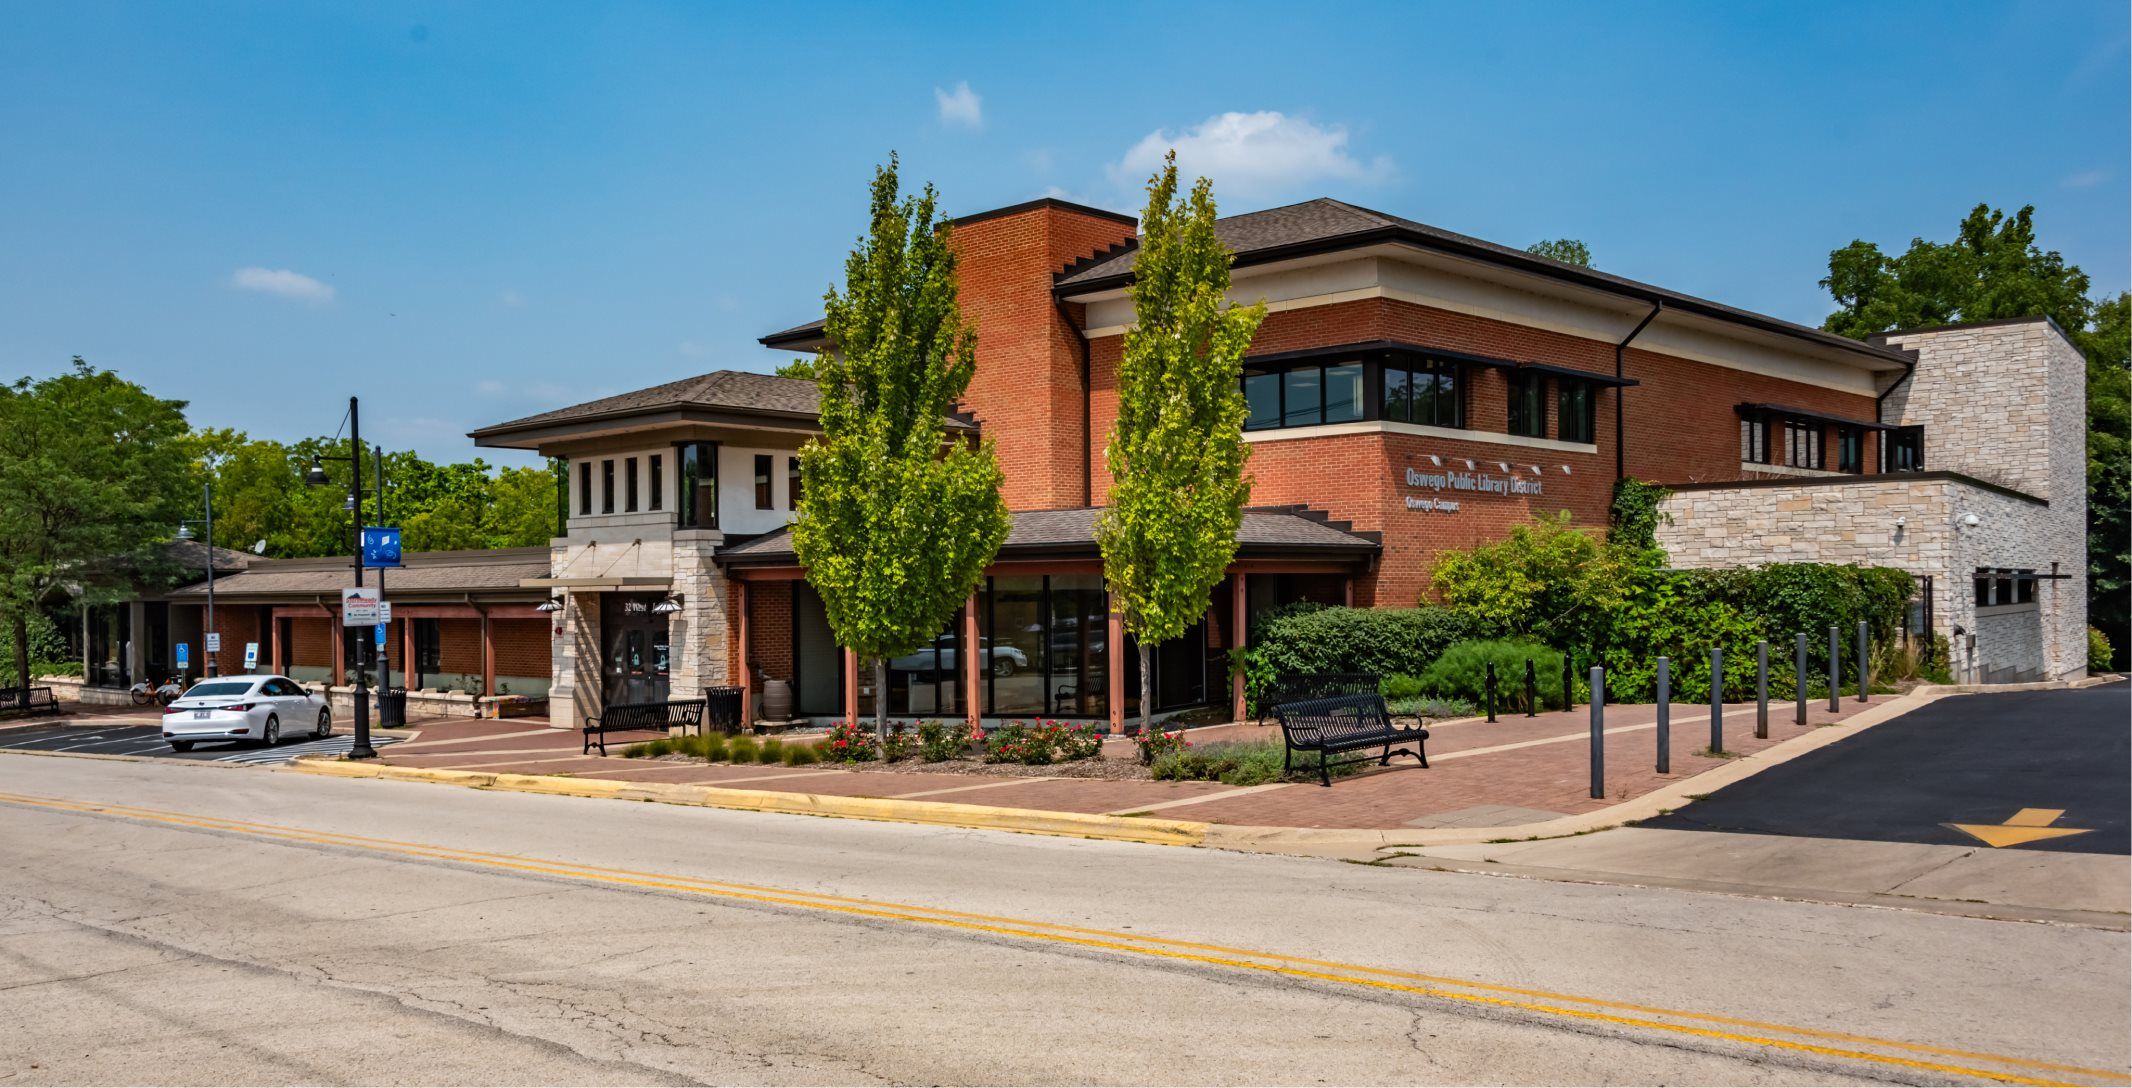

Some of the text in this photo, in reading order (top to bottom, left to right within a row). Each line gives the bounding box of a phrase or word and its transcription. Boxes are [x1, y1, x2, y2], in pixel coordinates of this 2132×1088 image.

[1407, 468, 1542, 496] Oswego Public Library District
[1406, 497, 1459, 512] Oswego Campus
[625, 603, 632, 611] 32
[633, 603, 647, 611] West
